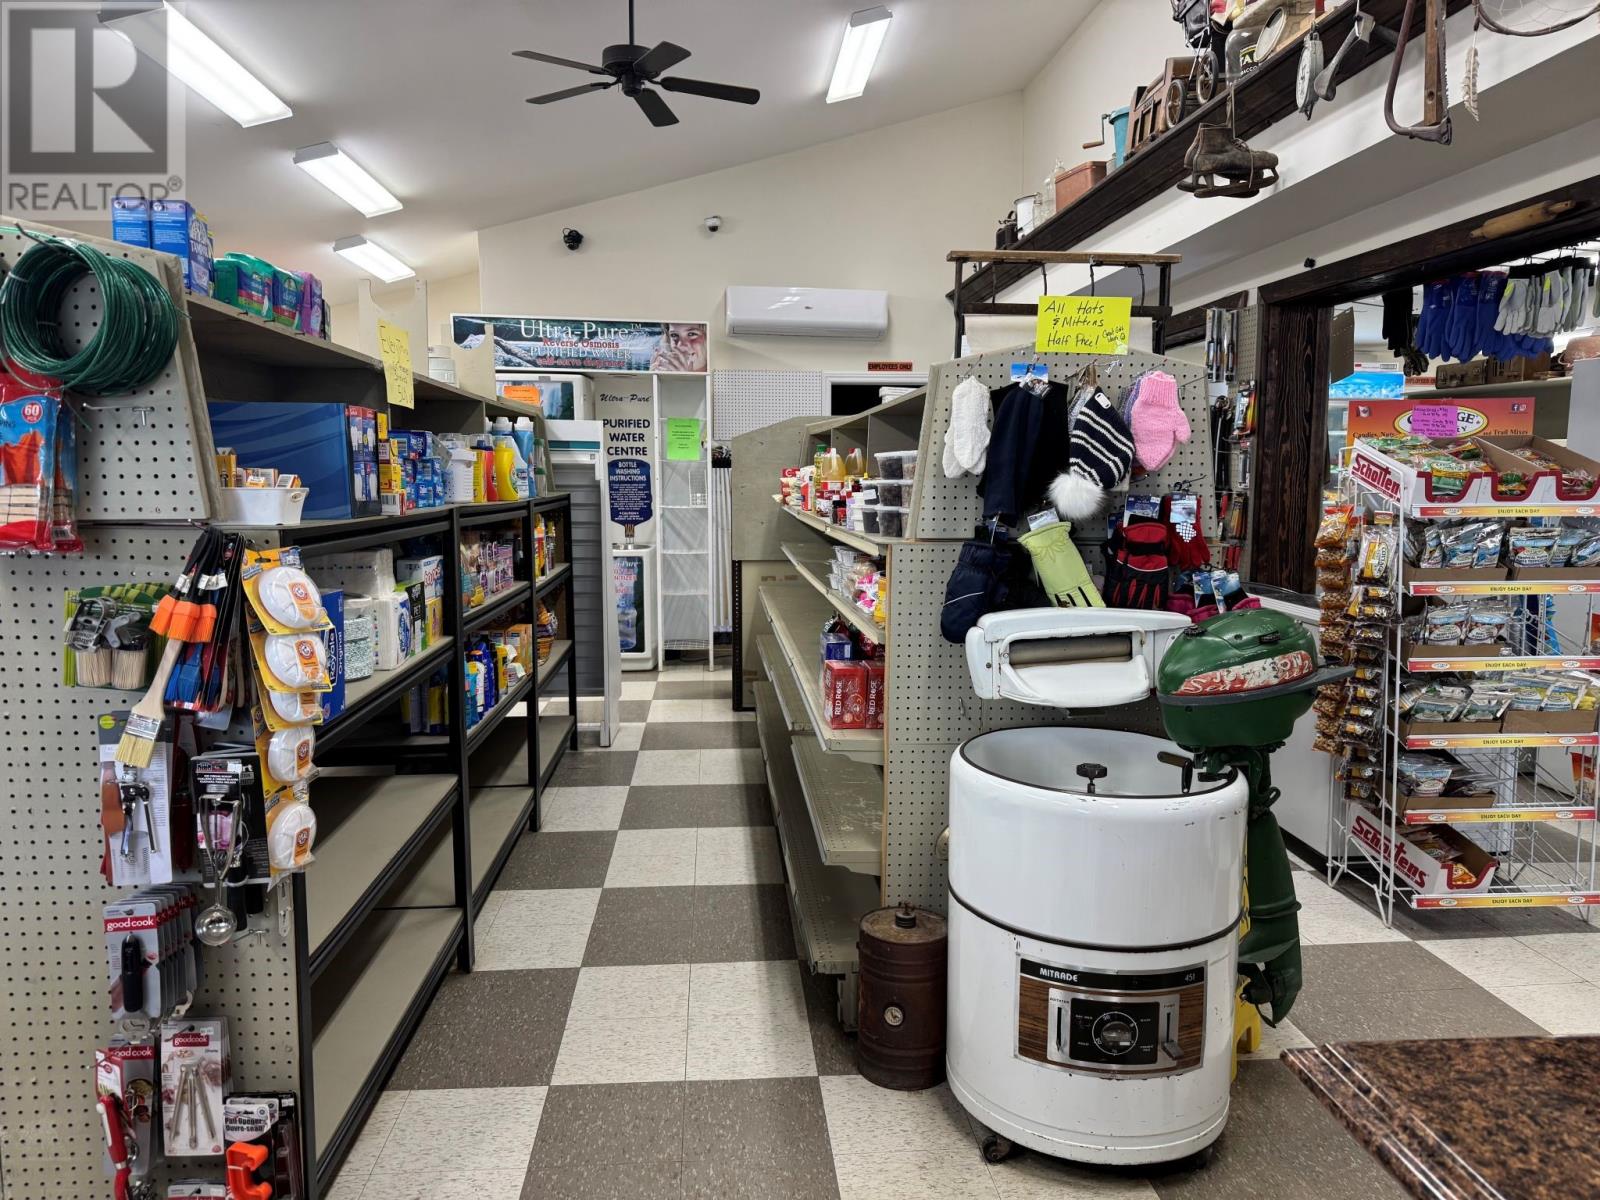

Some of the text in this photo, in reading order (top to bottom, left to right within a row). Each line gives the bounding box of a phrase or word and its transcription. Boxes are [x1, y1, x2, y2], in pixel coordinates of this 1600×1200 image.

[1044, 300, 1104, 315] All Hats
[1062, 315, 1104, 327] Mittens
[542, 337, 620, 349] Reverse Osmosis
[1048, 331, 1071, 347] Half
[530, 346, 632, 360] PURIFIED WATER
[24, 405, 40, 416] 60
[603, 419, 650, 428] PURIFIED
[609, 433, 645, 442] WATER
[607, 447, 648, 456] CENTRE
[835, 680, 843, 698] ROSE
[1039, 968, 1078, 982] MITRADE
